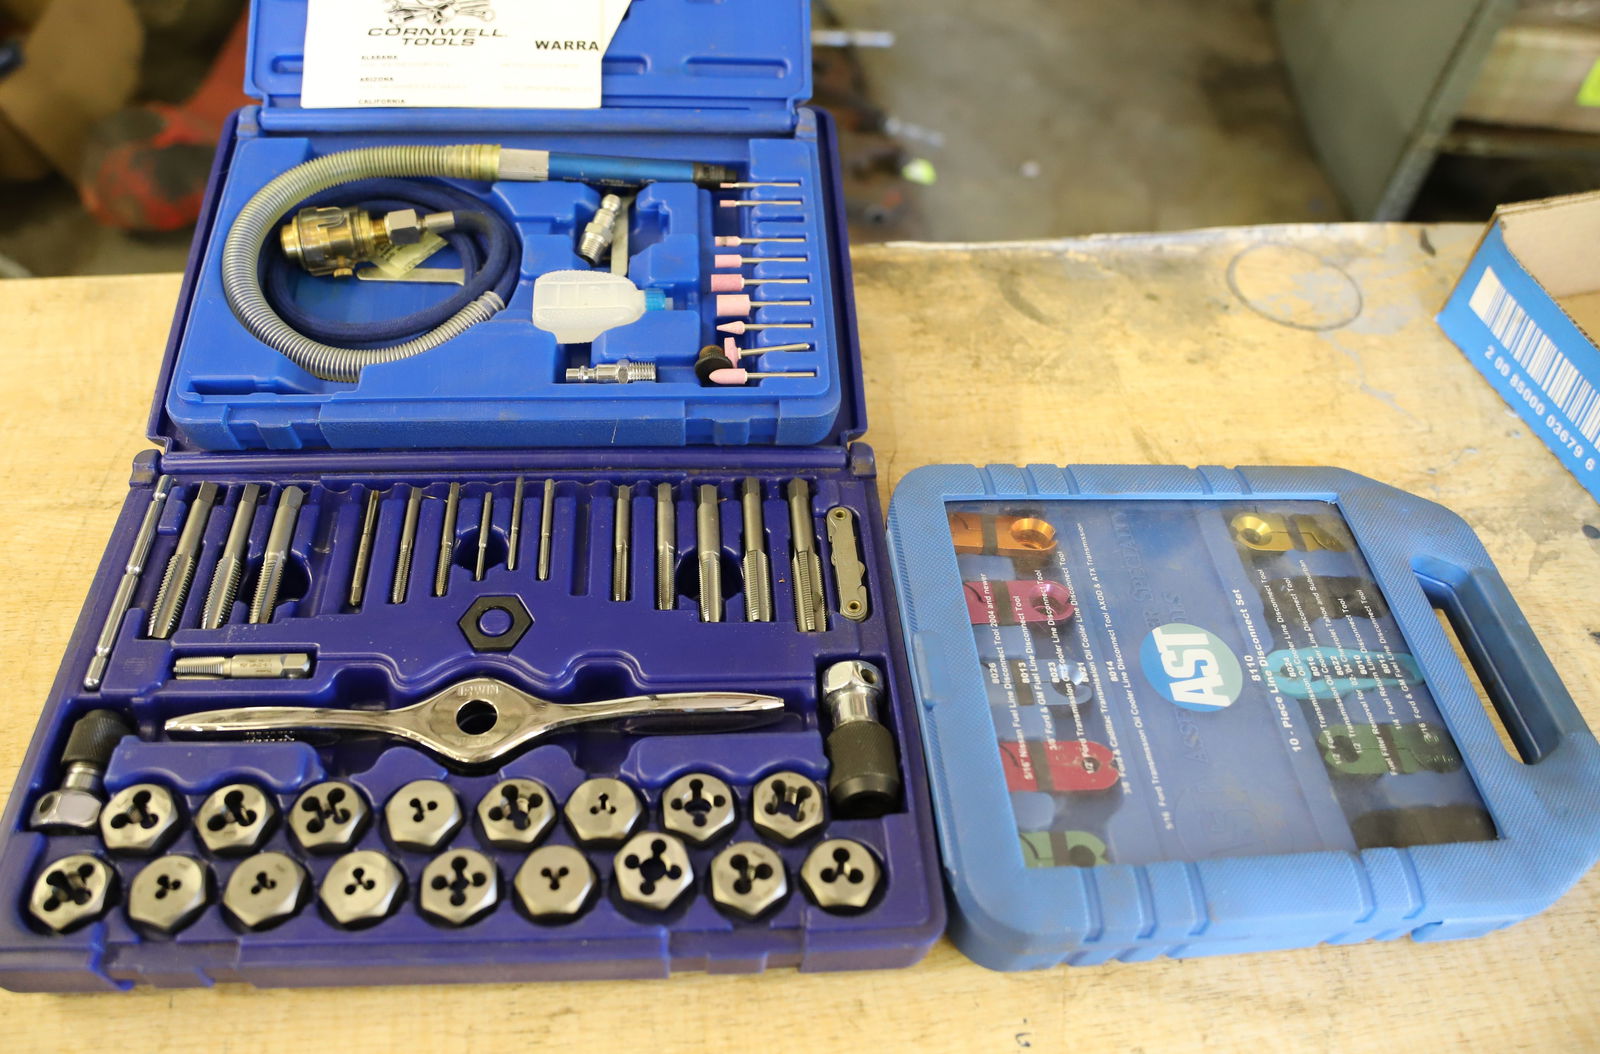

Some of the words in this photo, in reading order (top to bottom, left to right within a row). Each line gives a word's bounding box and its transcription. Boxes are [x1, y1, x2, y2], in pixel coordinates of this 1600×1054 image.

[367, 27, 504, 37] CORNWELL
[402, 37, 476, 46] TOOLS
[535, 39, 600, 51] WARRA
[1484, 344, 1496, 360] 2
[1494, 356, 1511, 377] 00
[1509, 373, 1546, 416] 85000
[1546, 414, 1584, 458] 03679
[1585, 457, 1596, 472] 6
[1074, 522, 1094, 566] Transmission
[1055, 550, 1067, 565] Tool
[978, 572, 990, 594] newer
[1033, 568, 1044, 584] Tool
[1088, 567, 1099, 582] ATX
[1255, 568, 1268, 583] Tool
[1281, 576, 1295, 591] Tool
[1296, 559, 1317, 591] Suburban
[1060, 567, 1078, 605] Disconnect
[1355, 588, 1368, 604] Tool
[983, 594, 994, 608] and
[1012, 595, 1023, 611] Tool
[1037, 585, 1055, 625] Disconnect
[1230, 588, 1245, 605] Set
[1262, 584, 1285, 622] Disconnect
[1311, 592, 1324, 605] and
[1336, 597, 1350, 612] Tool
[986, 609, 998, 627] 2004
[1071, 607, 1083, 622] Line
[1101, 612, 1113, 627] Tool
[1288, 592, 1312, 631] Disconnect
[1317, 605, 1333, 626] Tahoe
[1016, 612, 1034, 653] Disconnect
[1278, 623, 1292, 639] Line
[1344, 614, 1368, 653] Disconnect
[1362, 605, 1387, 643] Disconnect
[990, 627, 1002, 644] Tool
[1048, 626, 1060, 643] Line
[1076, 623, 1090, 648] Cooler
[1237, 608, 1269, 666] Disconnect
[1305, 632, 1319, 648] Line
[1083, 649, 1094, 660] Oil
[1106, 628, 1126, 670] Disconnect
[1285, 640, 1302, 664] Cooler
[1327, 628, 1349, 662] Chevrolet
[1381, 644, 1395, 660] Line
[994, 646, 1012, 689] Disconnect
[1026, 655, 1038, 671] Line
[1104, 660, 1119, 682] 8014
[1149, 625, 1233, 709] AST
[1242, 654, 1262, 681] 8110
[1281, 656, 1297, 677] 8024
[1295, 665, 1307, 676] Oil
[1305, 655, 1321, 676] 8016
[1312, 649, 1330, 673] Cooler
[1328, 655, 1345, 675] 8022
[1352, 654, 1368, 675] 8010
[1362, 654, 1376, 670] Line
[1375, 653, 1392, 674] 8012
[1388, 661, 1403, 677] Fuel
[987, 662, 1000, 684] 8026
[1017, 661, 1030, 683] 8013
[1031, 672, 1043, 690] Fuel
[1046, 661, 1060, 683] 8023
[1119, 671, 1132, 688] Line
[1261, 669, 1280, 693] Line
[1323, 674, 1335, 685] Oil
[1087, 661, 1109, 713] Transmission
[1369, 670, 1388, 696] Return
[1397, 678, 1410, 692] GM
[1004, 690, 1017, 708] Line
[1035, 691, 1047, 705] GM
[1124, 689, 1140, 715] Cooler
[1300, 677, 1328, 728] Transmission
[1353, 688, 1365, 699] for
[1063, 683, 1085, 736] Transmission
[1271, 695, 1294, 728] Piece
[1328, 686, 1357, 737] Transmission
[1381, 697, 1396, 714] Fuel
[1407, 699, 1422, 718] Ford
[1008, 709, 1021, 727] Fuel
[1041, 714, 1054, 733] Ford
[1132, 716, 1144, 728] Oil
[1359, 700, 1381, 734] Removal
[1102, 714, 1119, 747] Cadillac
[1321, 729, 1337, 749] Ford
[1013, 728, 1028, 758] Nissan
[1077, 738, 1091, 757] Ford
[1288, 737, 1303, 752] 10
[1374, 735, 1390, 756] Filter
[1113, 756, 1128, 777] Ford
[1136, 729, 1161, 784] Transmission
[1383, 756, 1399, 775] Fuel
